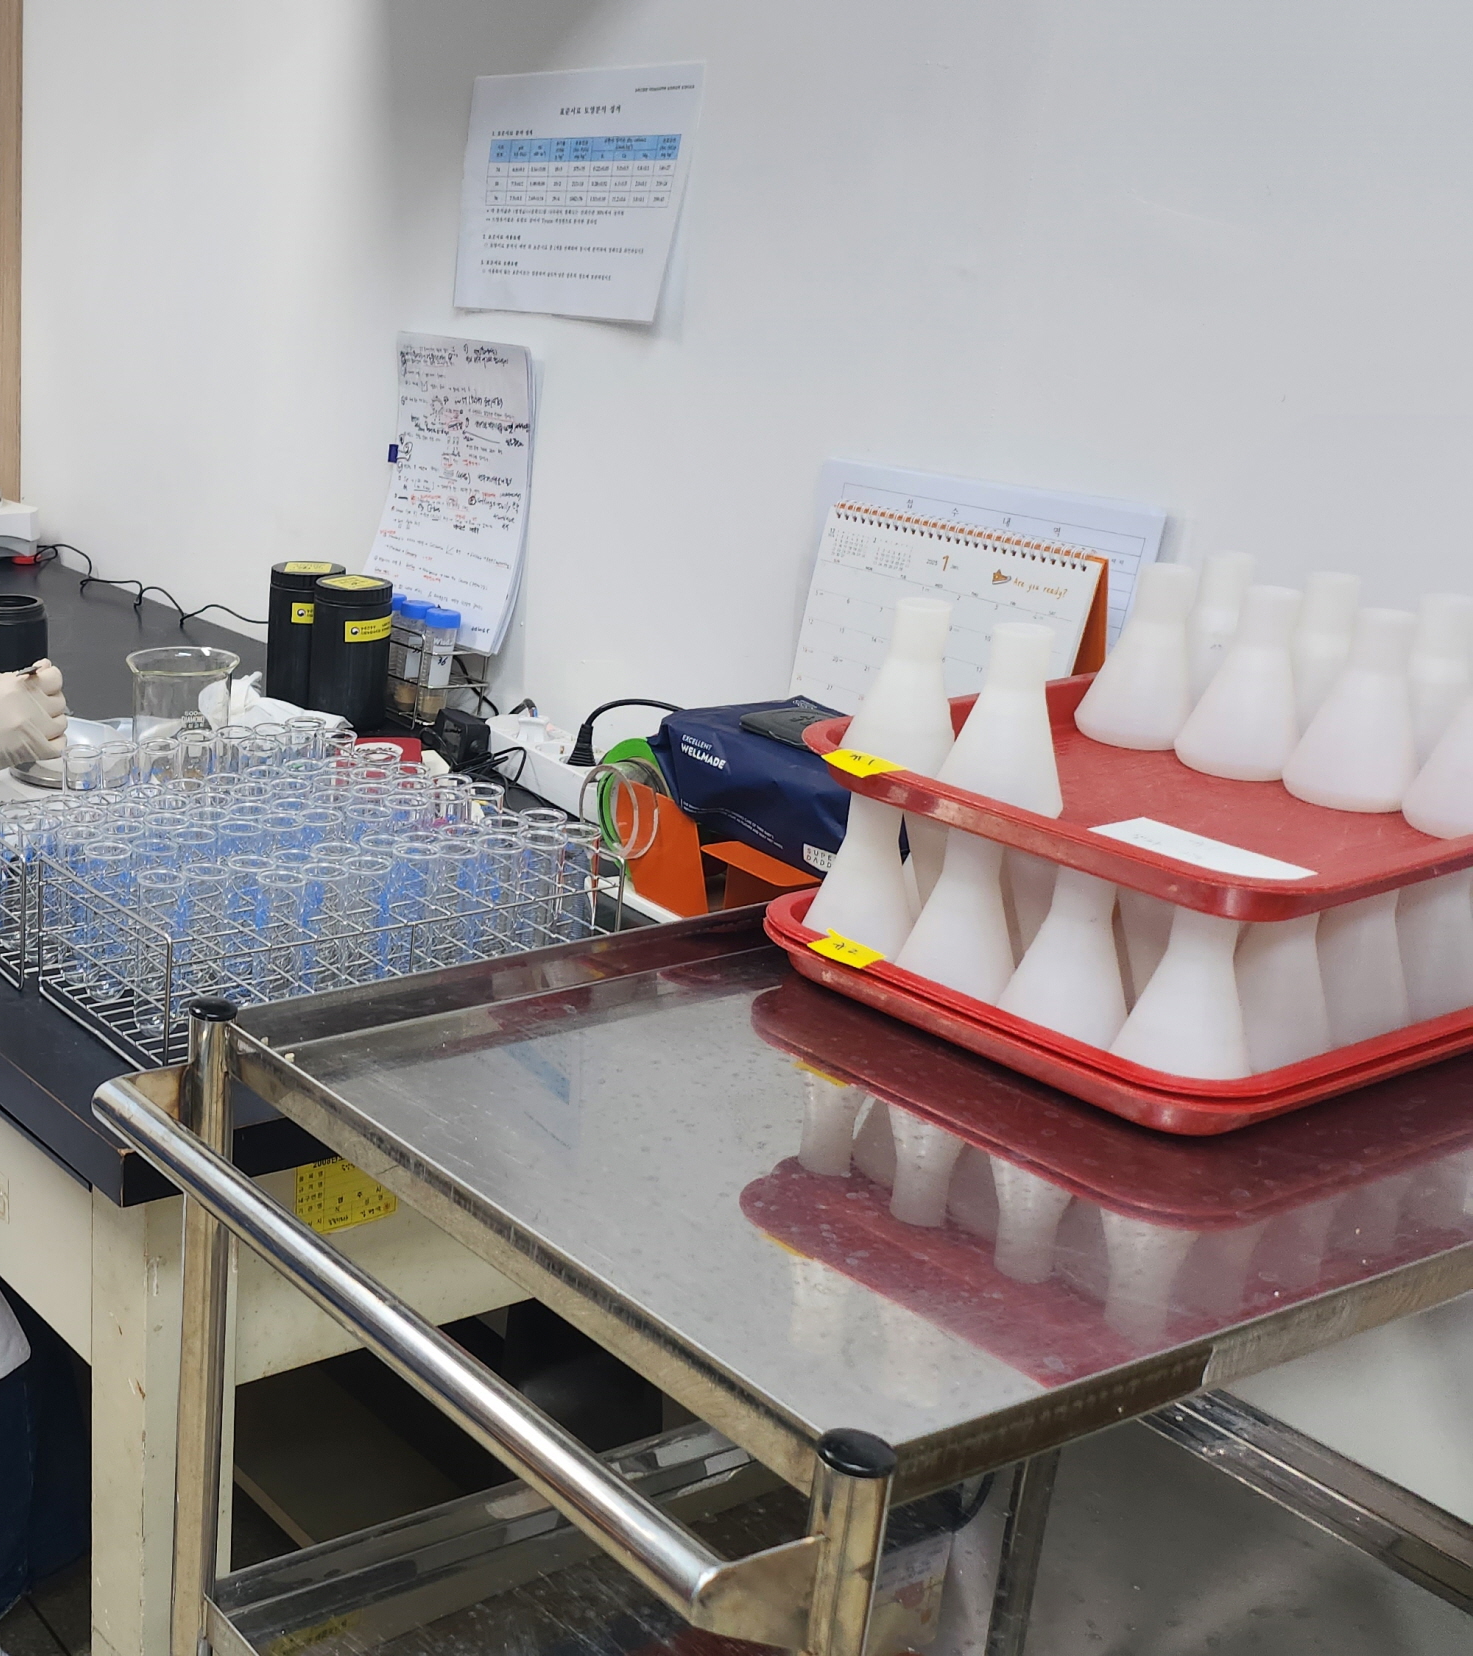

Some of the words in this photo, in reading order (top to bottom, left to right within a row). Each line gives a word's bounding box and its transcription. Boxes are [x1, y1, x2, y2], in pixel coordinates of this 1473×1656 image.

[942, 555, 949, 571] 1
[1013, 577, 1025, 587] Are
[1043, 586, 1068, 600] ready?
[682, 733, 713, 751] EXCELLENT
[680, 742, 727, 770] WELLMADE
[807, 848, 836, 862] SUPE
